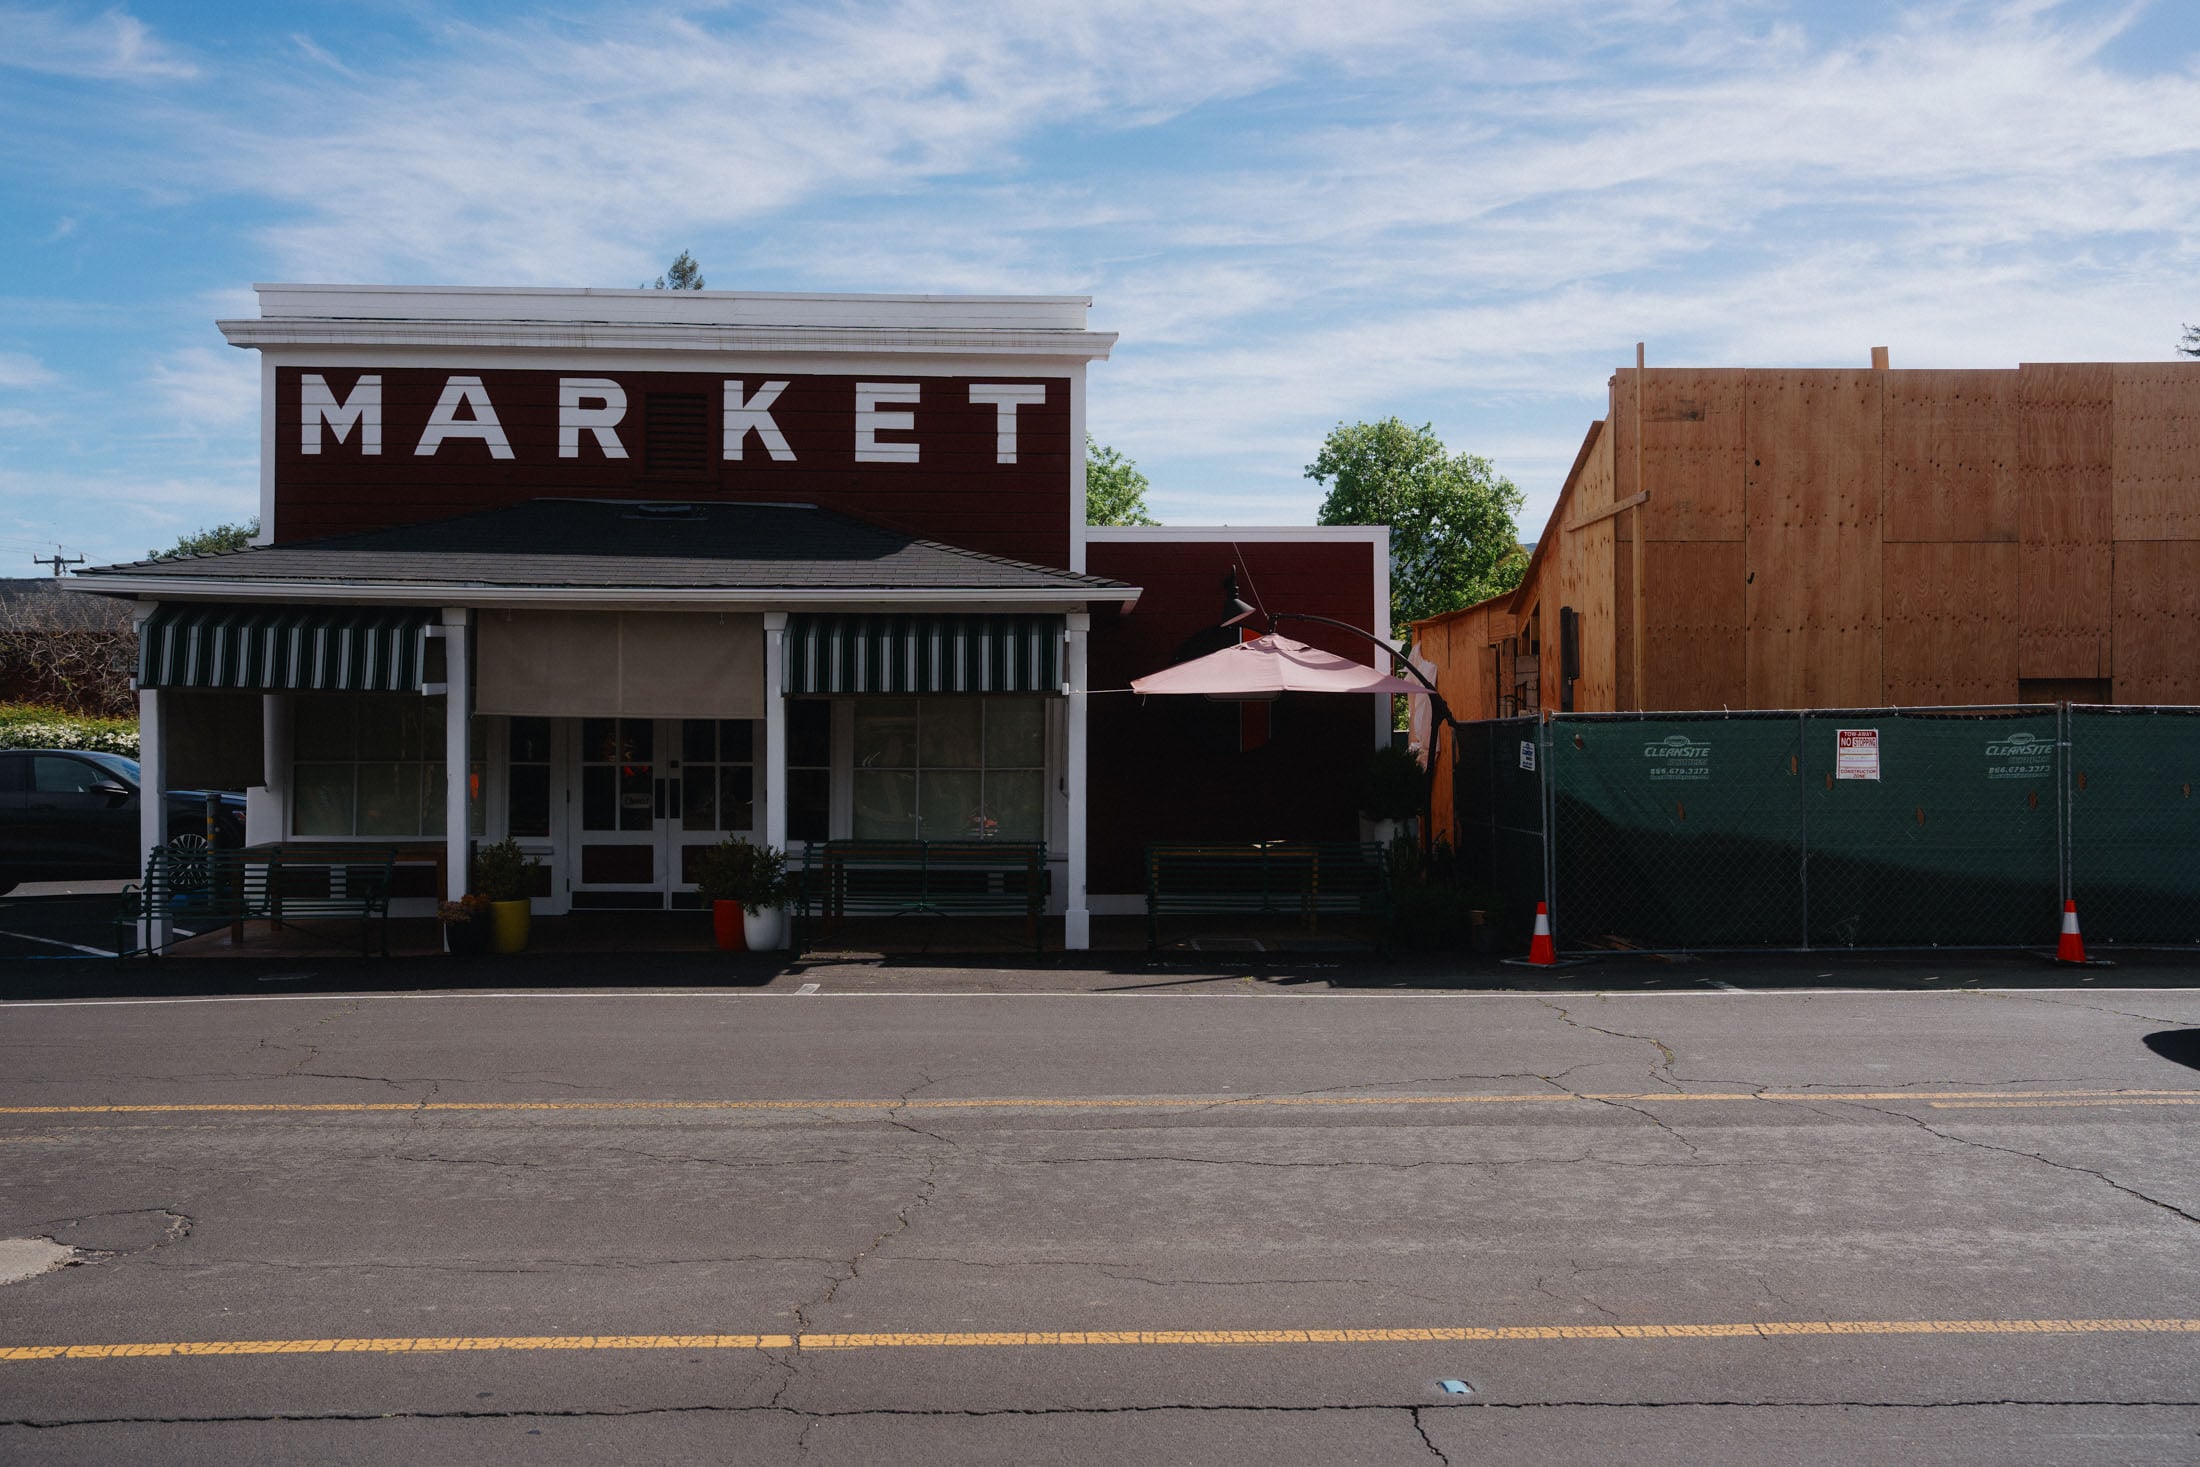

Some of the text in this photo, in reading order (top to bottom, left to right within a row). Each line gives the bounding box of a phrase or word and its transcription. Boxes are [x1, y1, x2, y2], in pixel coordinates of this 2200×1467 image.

[300, 374, 1047, 464] MARKET
[1841, 737, 1876, 747] NO STOPPING
